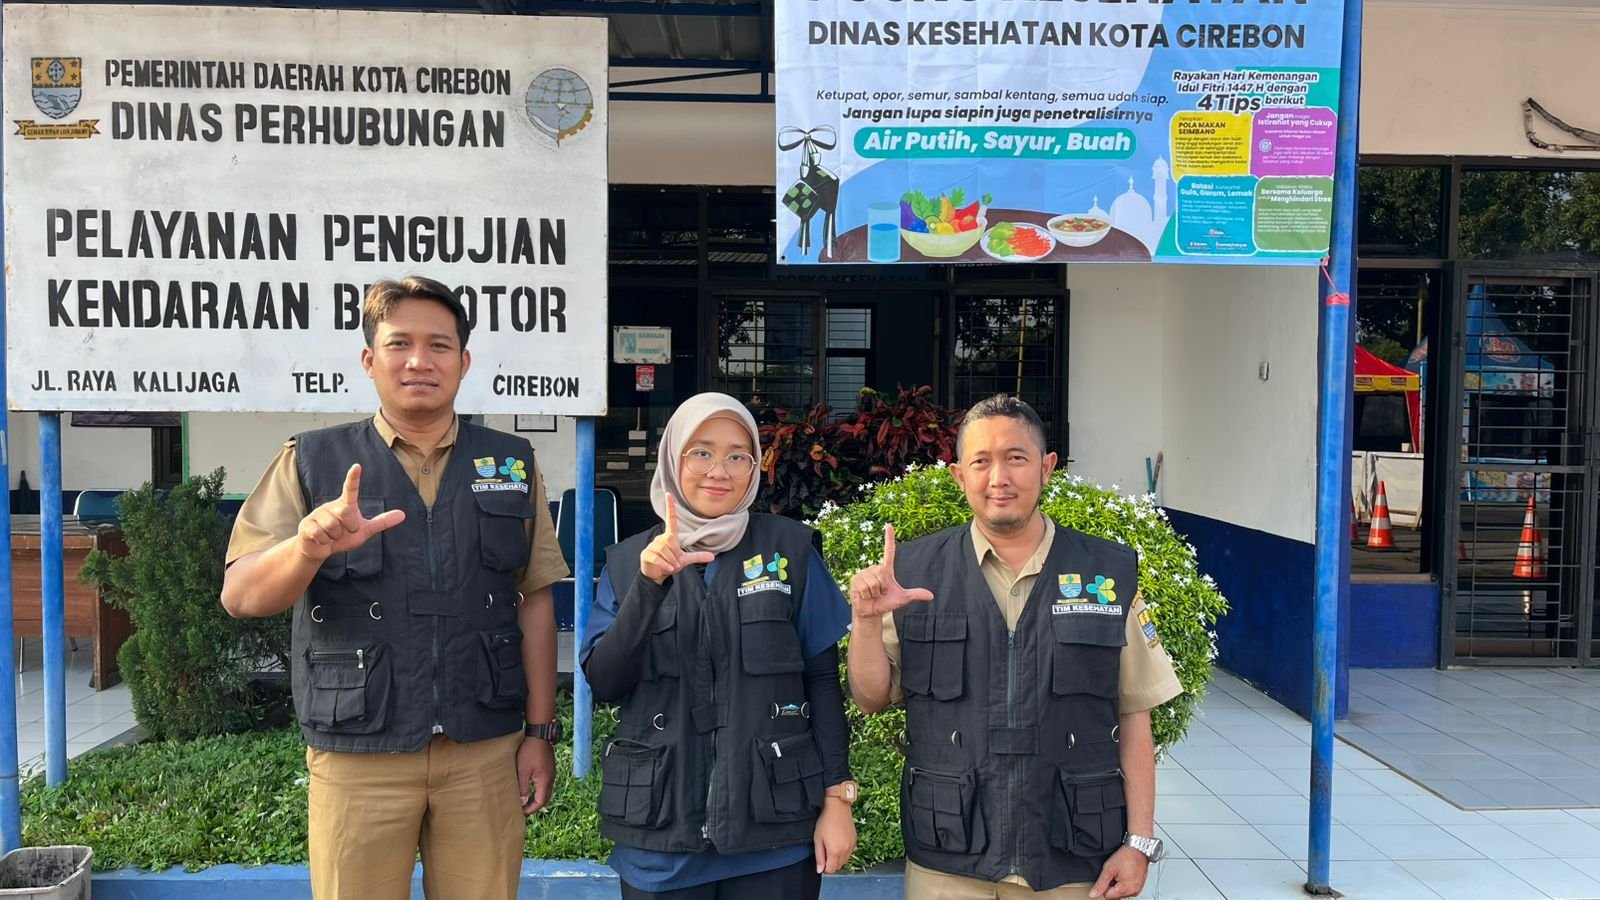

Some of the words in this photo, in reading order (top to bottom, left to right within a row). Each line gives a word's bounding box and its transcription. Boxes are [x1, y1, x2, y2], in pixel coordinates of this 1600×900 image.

[808, 21, 900, 45] DINAS
[907, 21, 1081, 46] KESEHATAN
[1089, 23, 1169, 48] KOTA
[1175, 24, 1305, 49] CIREBON
[106, 60, 245, 88] PEMERINTAH
[254, 63, 344, 91] DAERAH
[353, 66, 407, 93] KOTA
[416, 67, 510, 96] CIREBON
[1173, 72, 1219, 82] Rayakan
[1222, 72, 1245, 80] Hari
[1248, 72, 1318, 82] Kemenangan
[816, 89, 869, 103] Ketupat,
[873, 91, 904, 103] opor,
[908, 91, 950, 102] semur,
[954, 89, 1002, 100] sambal
[1005, 89, 1058, 104] kentang,
[1062, 92, 1105, 101] semua
[1108, 91, 1138, 102] udah
[1141, 94, 1169, 107] siap.
[1178, 83, 1199, 92] Idul
[1202, 83, 1225, 92] Fitri
[1228, 83, 1253, 92] 1447
[1256, 84, 1264, 92] H
[1267, 84, 1307, 94] dengan
[1198, 94, 1213, 110] 4
[1215, 94, 1261, 114] Tips
[1265, 95, 1304, 105] berikut
[843, 107, 903, 123] Jangan
[906, 107, 942, 123] lupa
[944, 105, 994, 122] siapin
[995, 105, 1031, 122] juga
[1033, 106, 1153, 124] penetralisirnya
[1266, 112, 1294, 120] Jangan
[1309, 120, 1333, 128] Cukup
[112, 102, 222, 142] DINAS
[235, 104, 504, 147] PERHUBUNGAN
[863, 129, 902, 151] Air
[905, 129, 978, 153] Putih,
[984, 131, 1061, 156] Sayur,
[1066, 132, 1131, 151] Buah
[1271, 196, 1313, 204] Menghindari
[47, 209, 296, 260] PELAYANAN
[324, 215, 566, 266] PENGUJIAN
[48, 279, 309, 329] KENDARAAN
[68, 370, 116, 391] RAYA
[134, 371, 240, 393] KALIJAGA
[292, 372, 349, 394] TELP.
[492, 375, 579, 398] CIREBON
[740, 585, 754, 595] TIM
[1072, 605, 1120, 613] KESEHATAN
